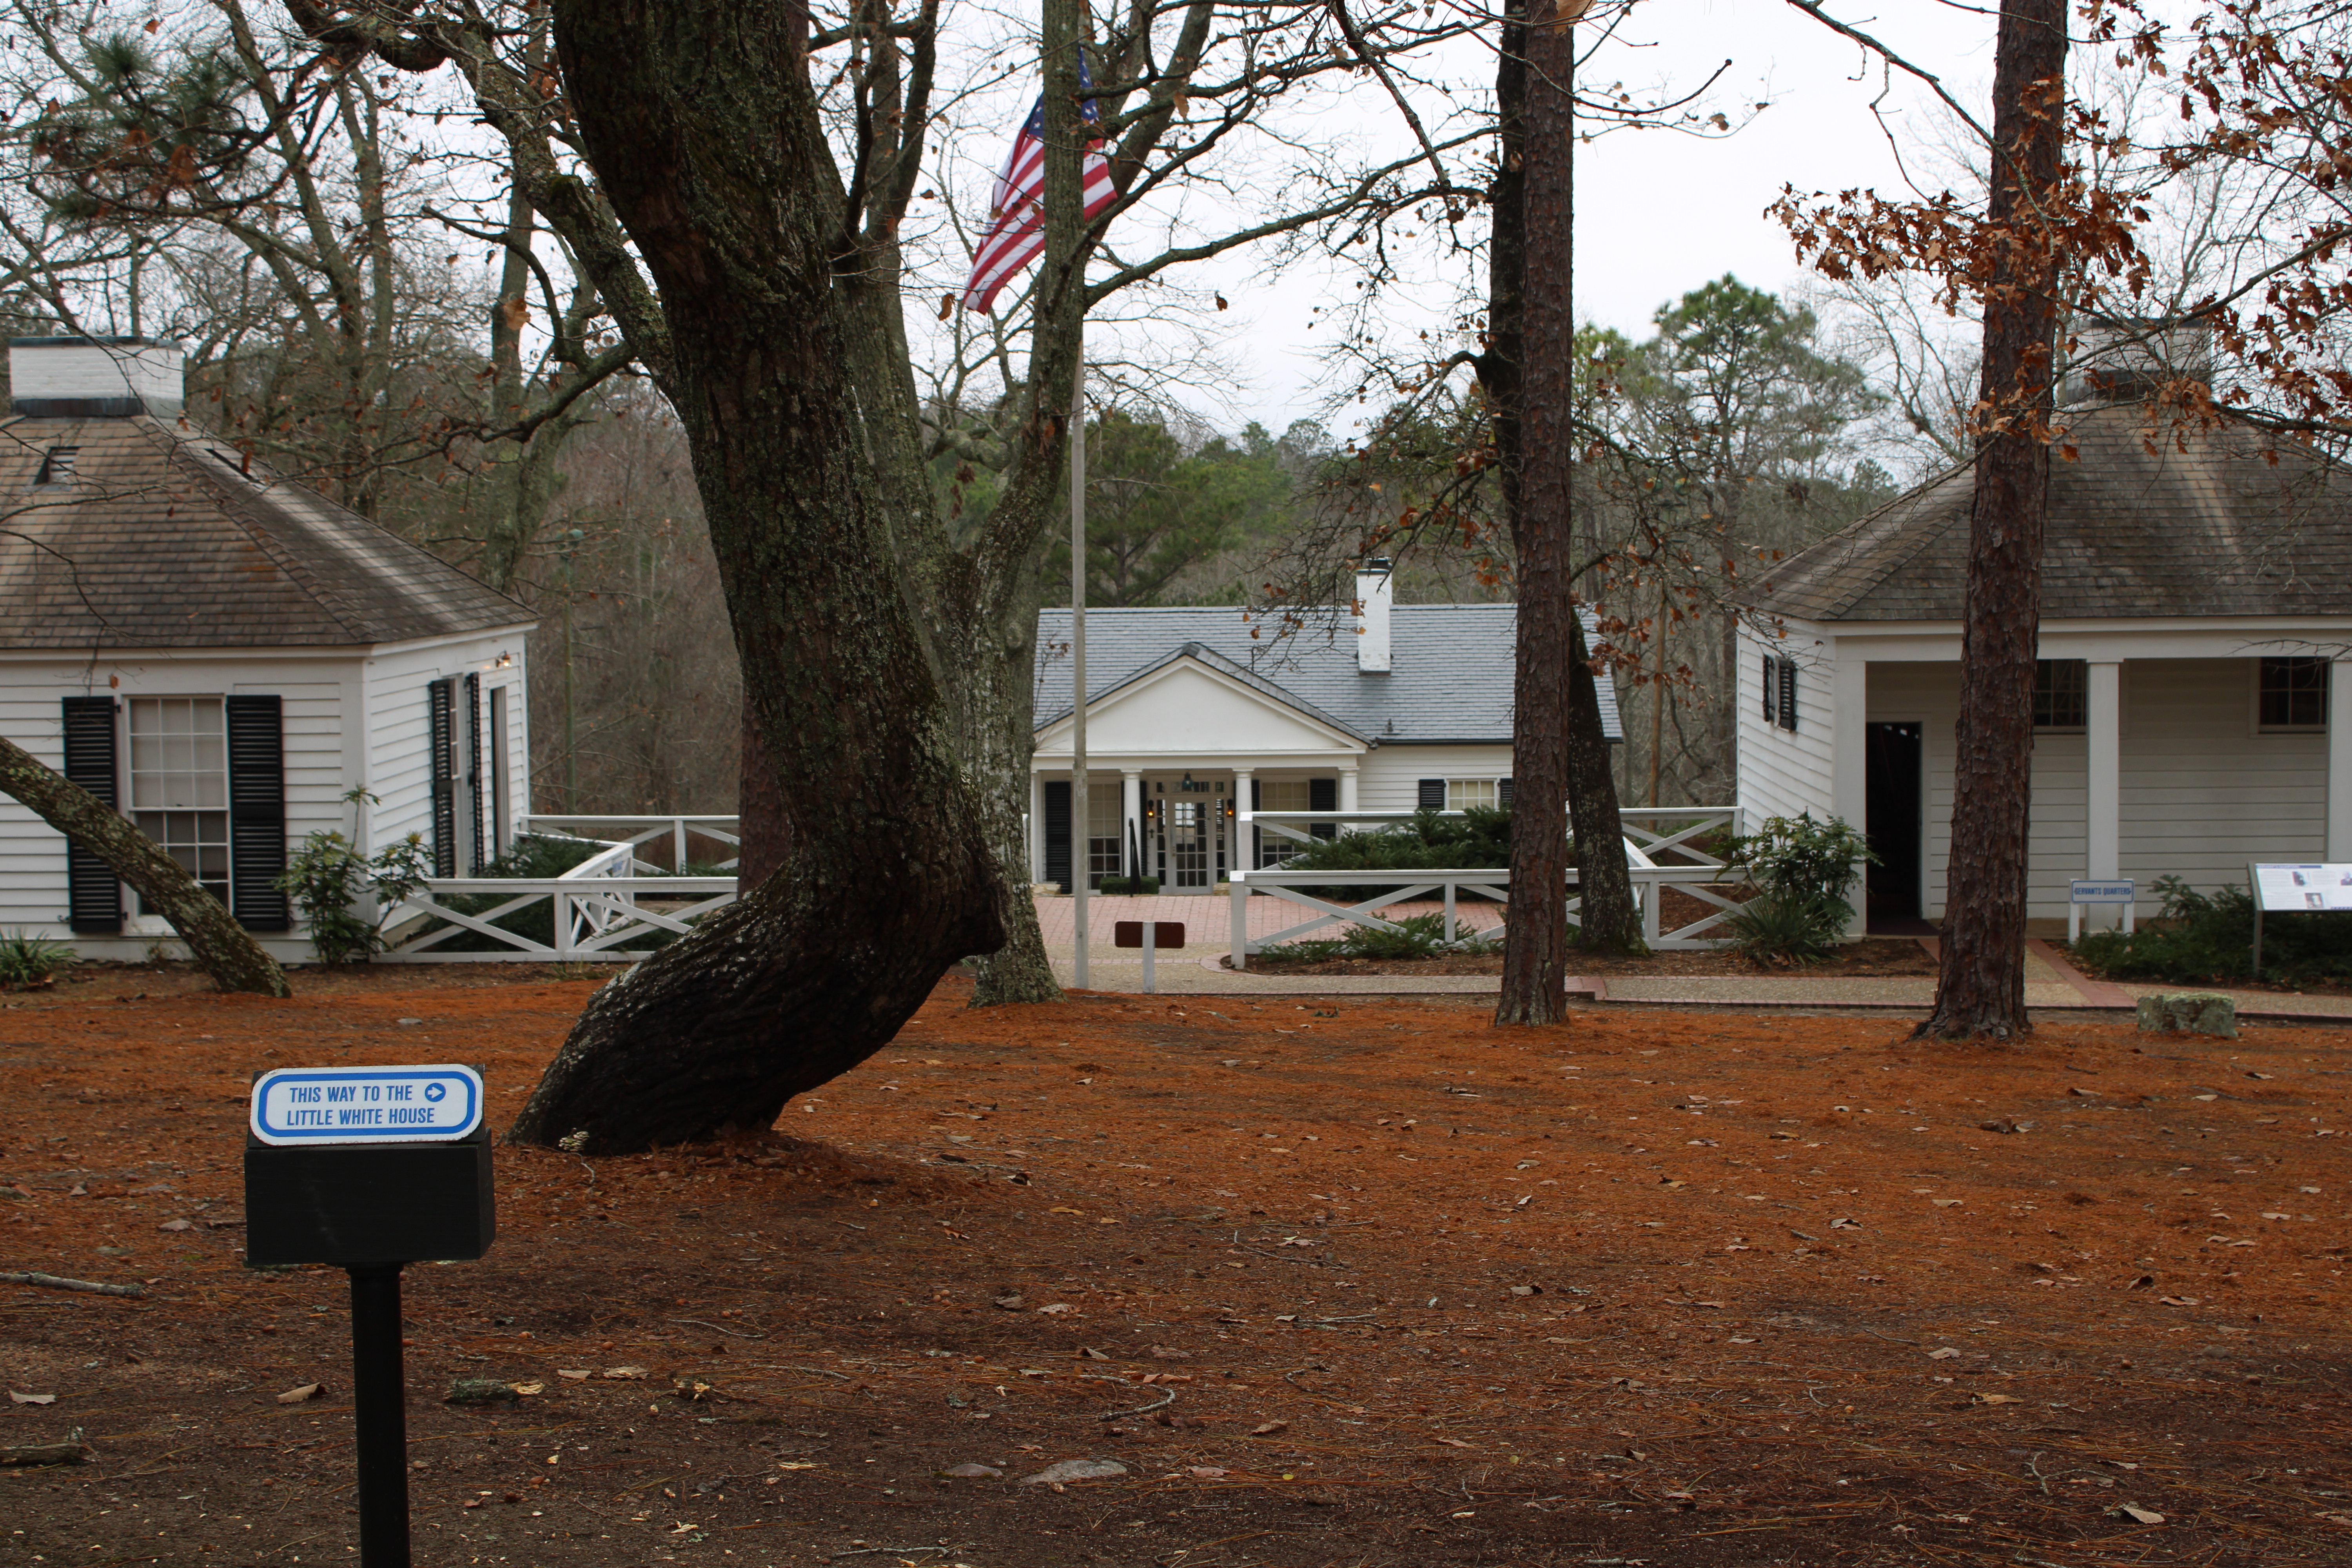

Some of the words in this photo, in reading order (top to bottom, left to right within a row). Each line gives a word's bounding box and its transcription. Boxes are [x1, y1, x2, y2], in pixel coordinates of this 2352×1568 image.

[289, 1087, 321, 1103] THIS
[327, 1086, 356, 1102] WAY
[362, 1085, 380, 1102] TO
[386, 1085, 413, 1101] THE
[286, 1109, 333, 1126] LITTLE
[339, 1109, 383, 1125] WHITE
[388, 1108, 435, 1124] HOUSE
